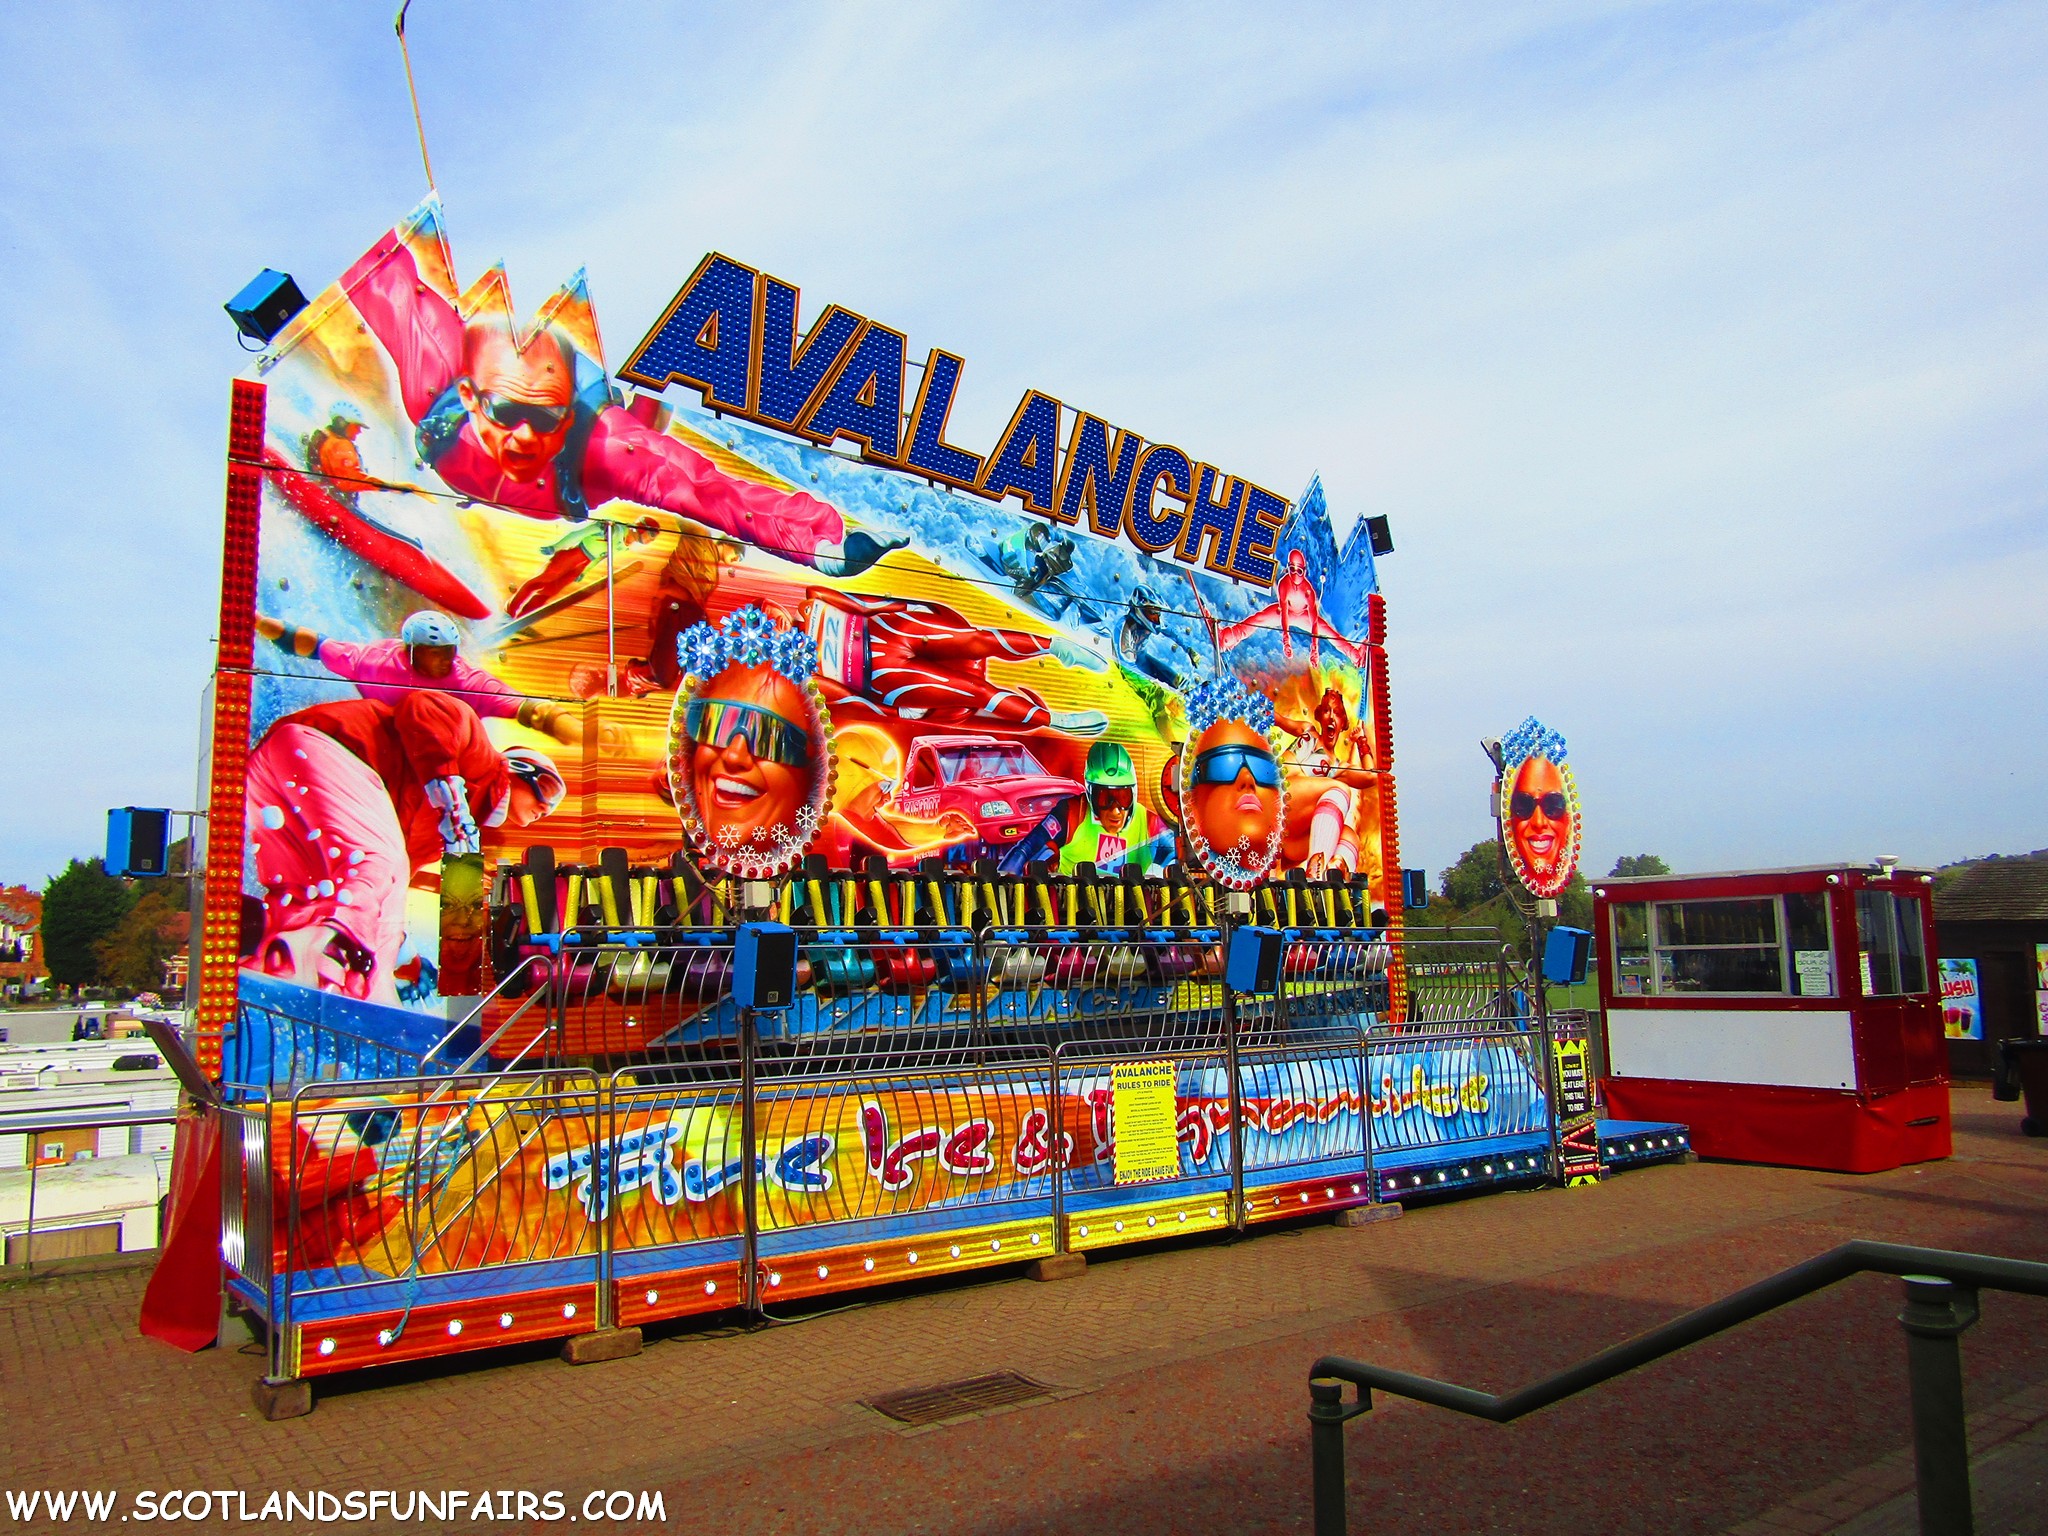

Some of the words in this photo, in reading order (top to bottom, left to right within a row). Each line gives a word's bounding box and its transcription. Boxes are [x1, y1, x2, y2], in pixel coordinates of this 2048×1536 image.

[615, 251, 1291, 588] AVALANCHE
[1115, 1065, 1172, 1078] AVALANCHE
[1116, 1081, 1141, 1090] RULES
[1142, 1080, 1152, 1088] TO
[1153, 1079, 1171, 1087] RIDE
[1011, 1107, 1073, 1175] &
[1120, 1170, 1132, 1180] ENJOY
[1133, 1168, 1141, 1178] THE
[1142, 1167, 1151, 1177] RIDE
[1155, 1165, 1165, 1175] HAVE
